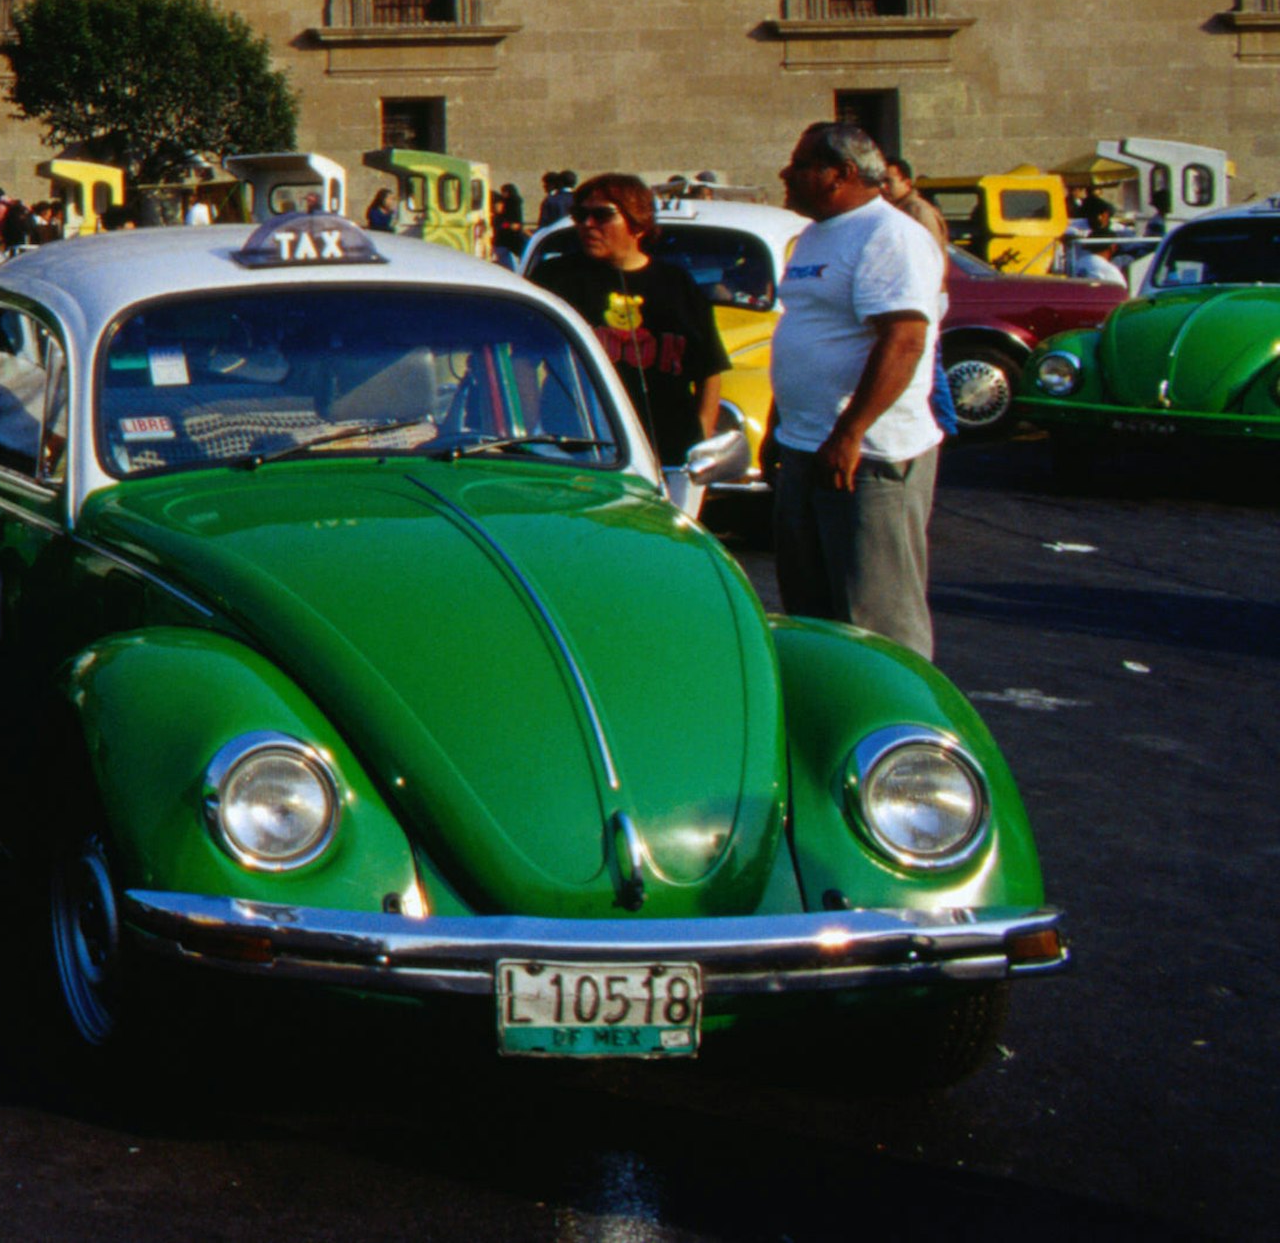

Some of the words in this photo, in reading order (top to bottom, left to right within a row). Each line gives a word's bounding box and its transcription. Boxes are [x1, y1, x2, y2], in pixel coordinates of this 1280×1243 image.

[121, 419, 171, 433] LIBRE
[552, 1028, 581, 1046] DF
[594, 1028, 640, 1047] MEX
